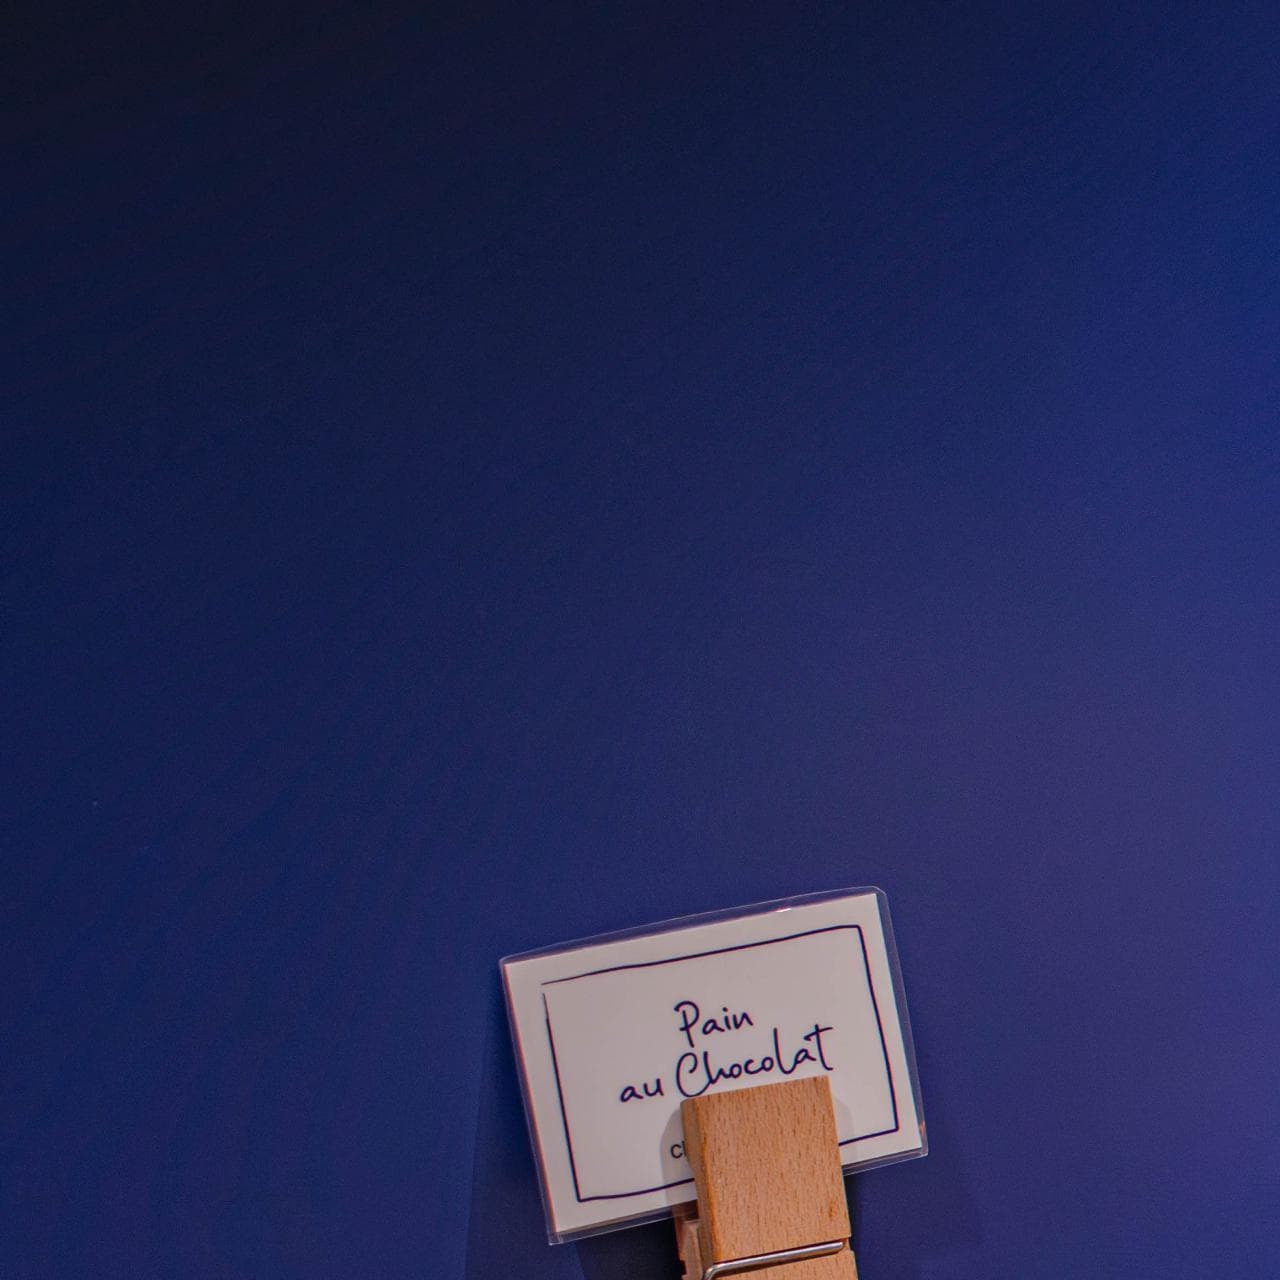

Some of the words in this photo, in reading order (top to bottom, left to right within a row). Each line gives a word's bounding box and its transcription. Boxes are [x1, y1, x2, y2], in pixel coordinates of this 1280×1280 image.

[673, 1000, 754, 1049] Pain
[619, 1078, 665, 1103] au
[675, 1023, 834, 1098] Chocolat
